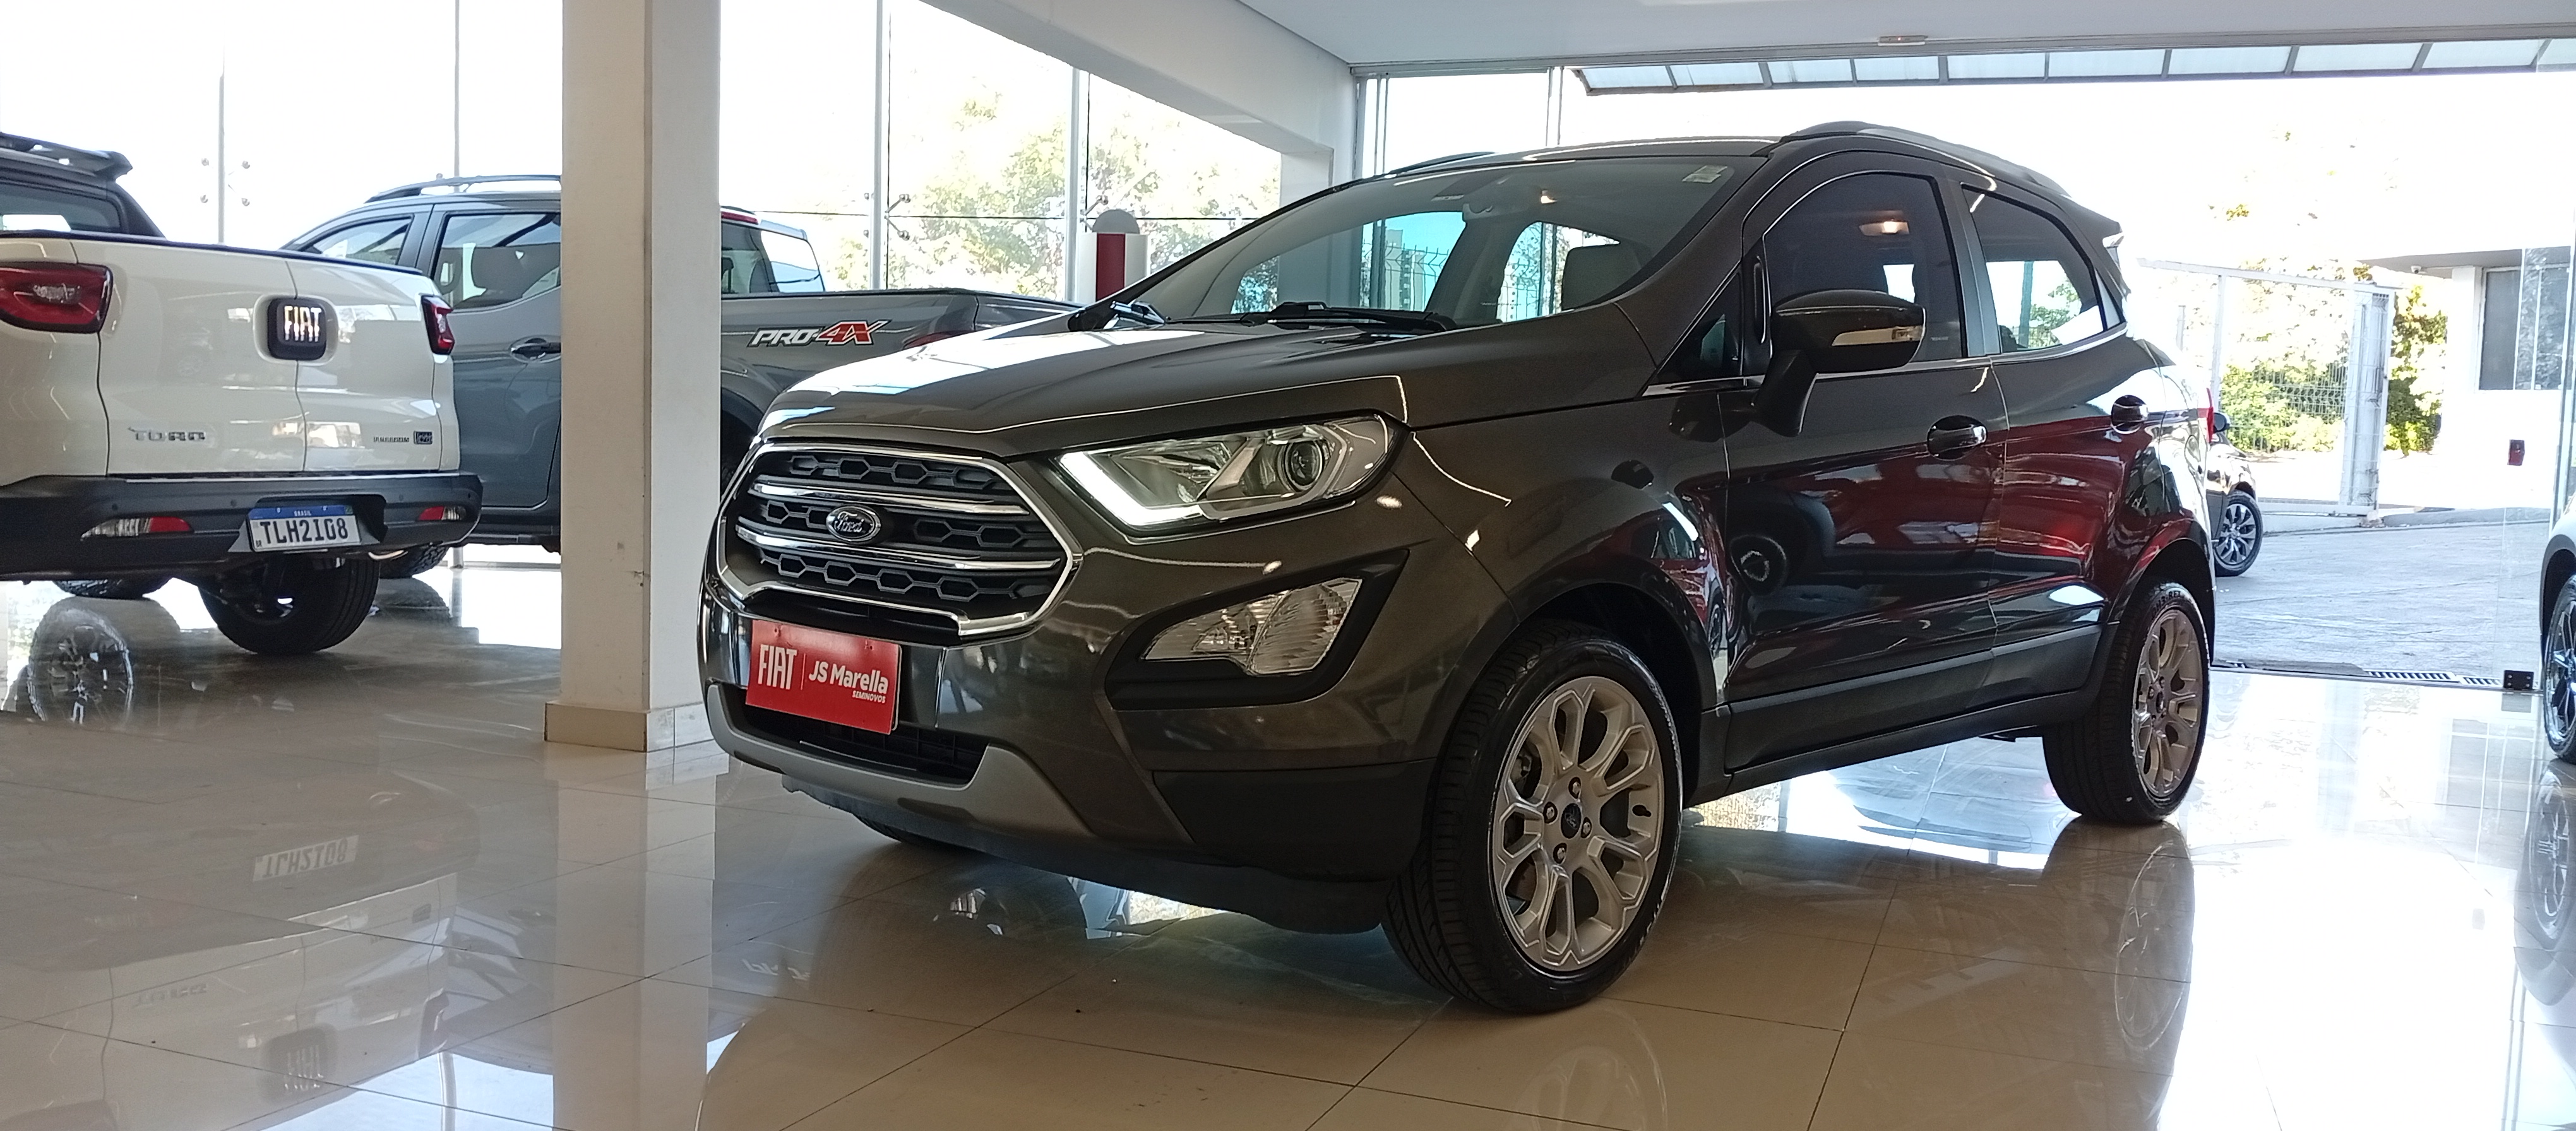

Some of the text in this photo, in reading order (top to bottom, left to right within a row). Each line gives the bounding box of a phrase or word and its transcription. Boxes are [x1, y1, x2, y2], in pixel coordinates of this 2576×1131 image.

[284, 305, 322, 342] FIAT
[259, 518, 348, 544] TLH2I08
[834, 511, 864, 533] Ford
[758, 644, 797, 690] FIAT
[809, 661, 889, 694] JS Marella
[852, 690, 886, 704] SEMINOVOS
